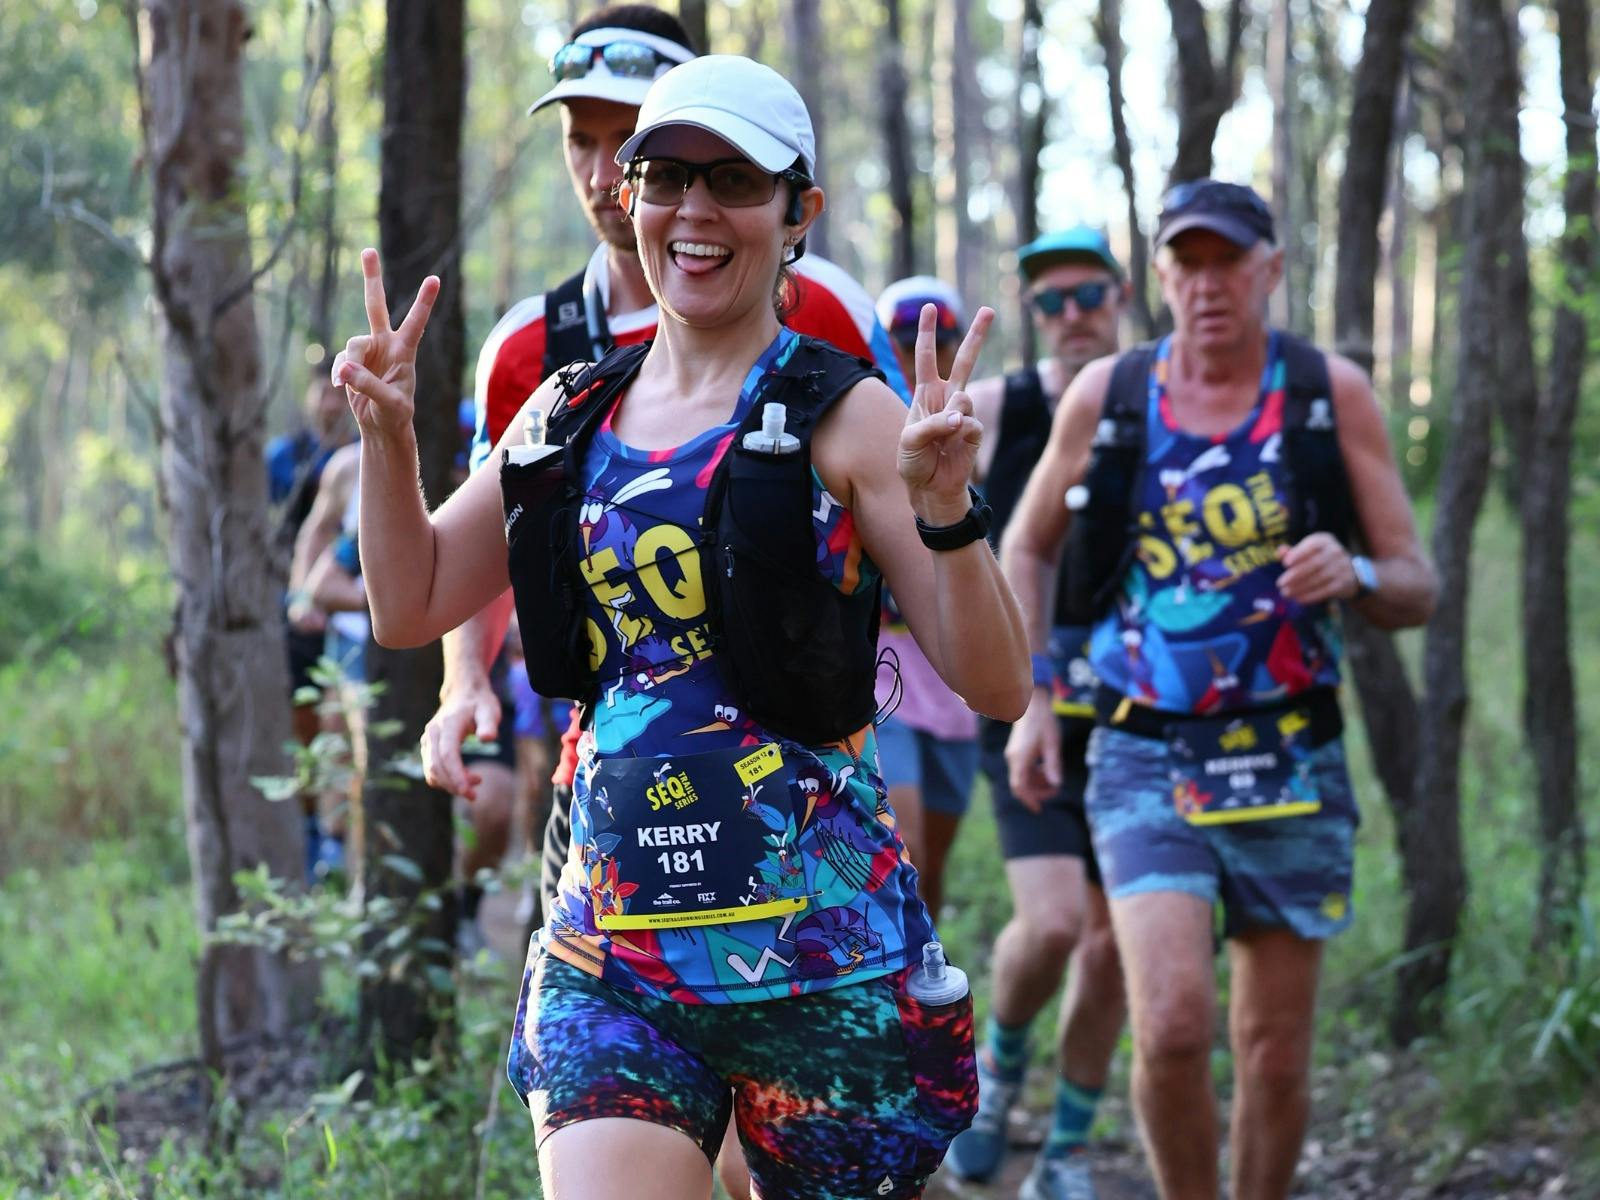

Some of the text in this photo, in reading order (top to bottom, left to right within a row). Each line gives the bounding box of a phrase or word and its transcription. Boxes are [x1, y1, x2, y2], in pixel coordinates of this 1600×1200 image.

[740, 755, 761, 770] SEASON
[748, 765, 763, 776] 181
[646, 776, 687, 811] SEQ
[678, 771, 695, 795] TRAIL
[674, 792, 699, 810] SERIES
[637, 821, 722, 847] KERRY
[657, 850, 705, 874] 181
[697, 892, 717, 902] FIXX
